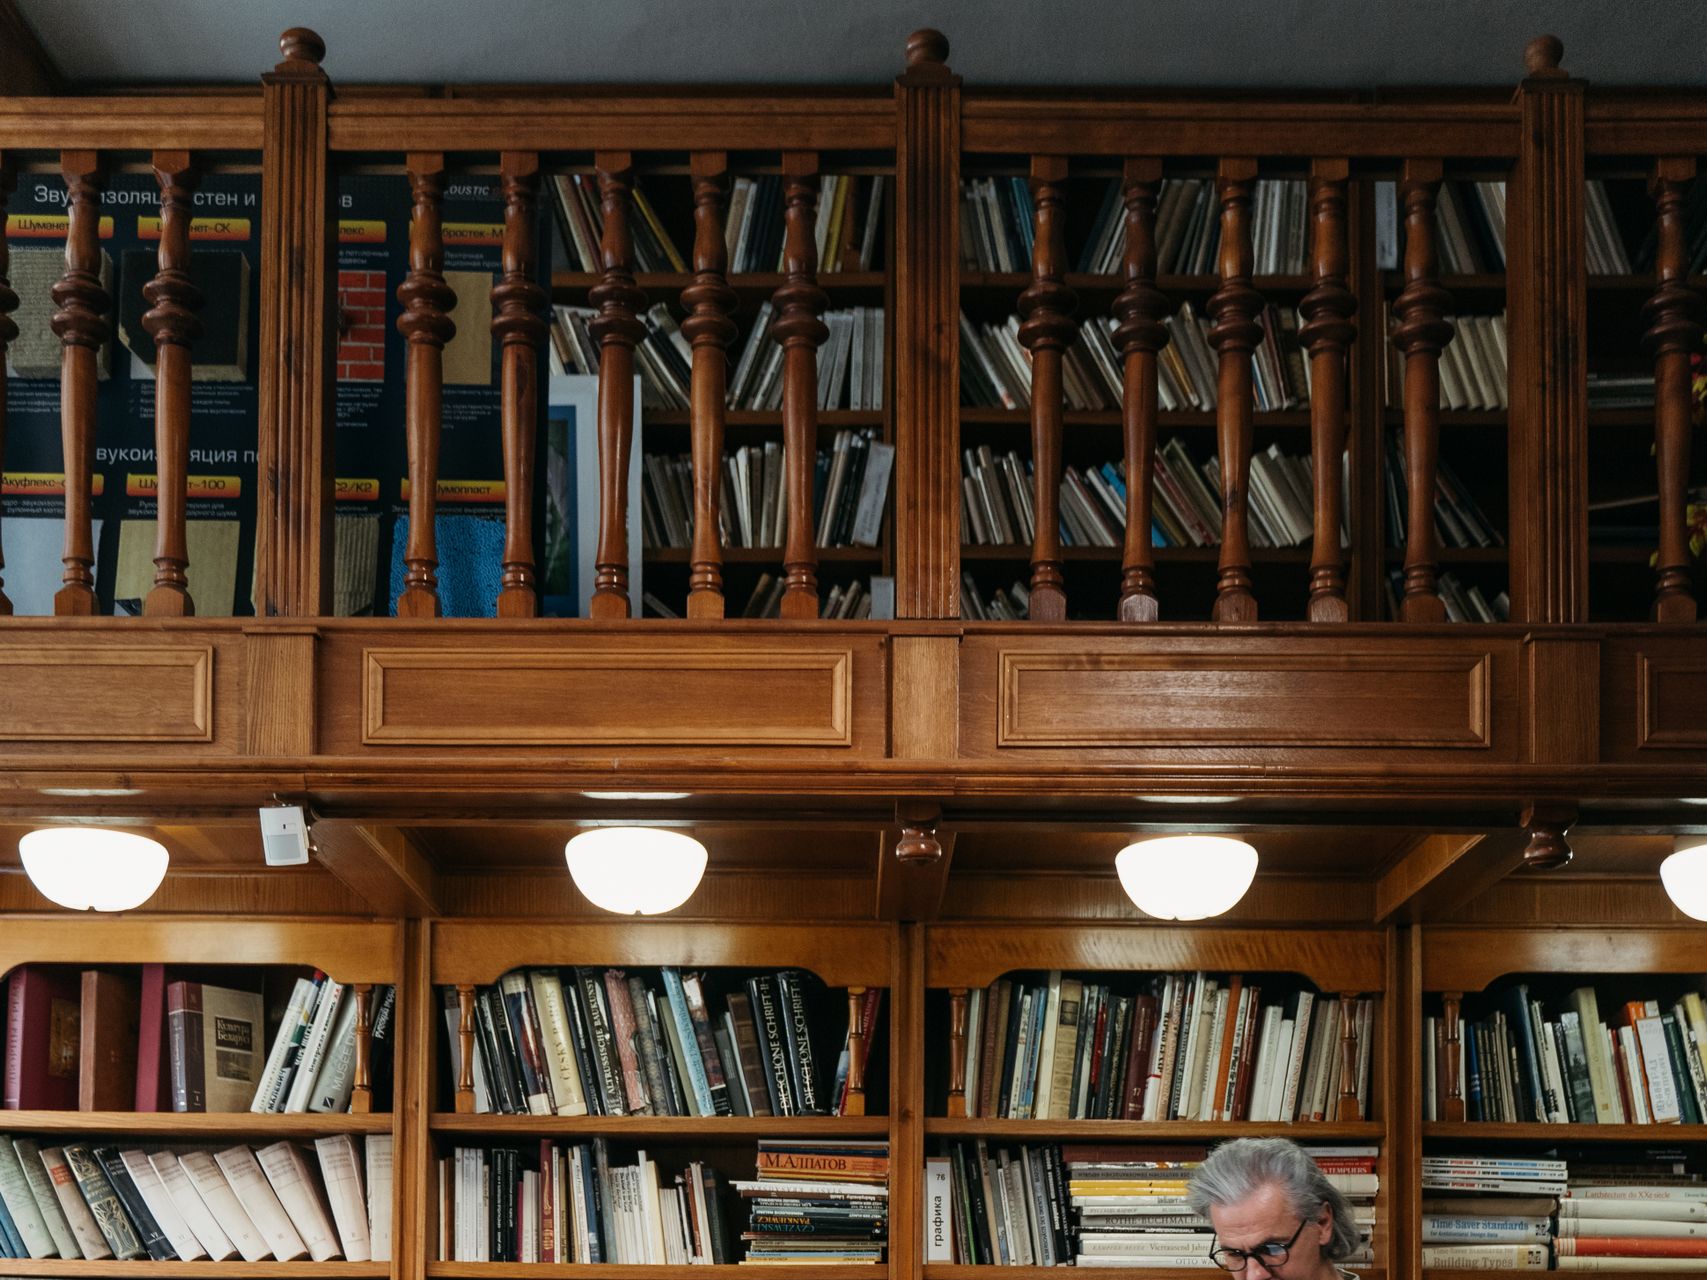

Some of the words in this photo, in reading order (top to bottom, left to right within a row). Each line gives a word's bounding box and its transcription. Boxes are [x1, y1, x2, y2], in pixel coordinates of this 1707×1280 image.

[194, 192, 238, 206] стен
[244, 193, 256, 206] и
[585, 978, 599, 1026] BAUKUNST
[790, 986, 806, 1034] SCHRIFT
[760, 994, 776, 1040] SCHRIFT
[595, 1027, 616, 1095] ALTRUSSISCHE
[266, 1068, 287, 1112] МАЛЕВИЧ
[803, 1085, 816, 1106] DIE
[777, 1089, 790, 1109] DIE
[935, 1173, 946, 1181] 76
[757, 1215, 811, 1225] PANKIEWICZ
[931, 1195, 944, 1248] графика
[1105, 1215, 1137, 1225] ROTHE
[1481, 1219, 1529, 1231] Standards
[1149, 1243, 1191, 1252] Viertausend
[1175, 1257, 1199, 1265] OTTO
[1433, 1257, 1479, 1269] Building
[1481, 1257, 1514, 1270] Types
